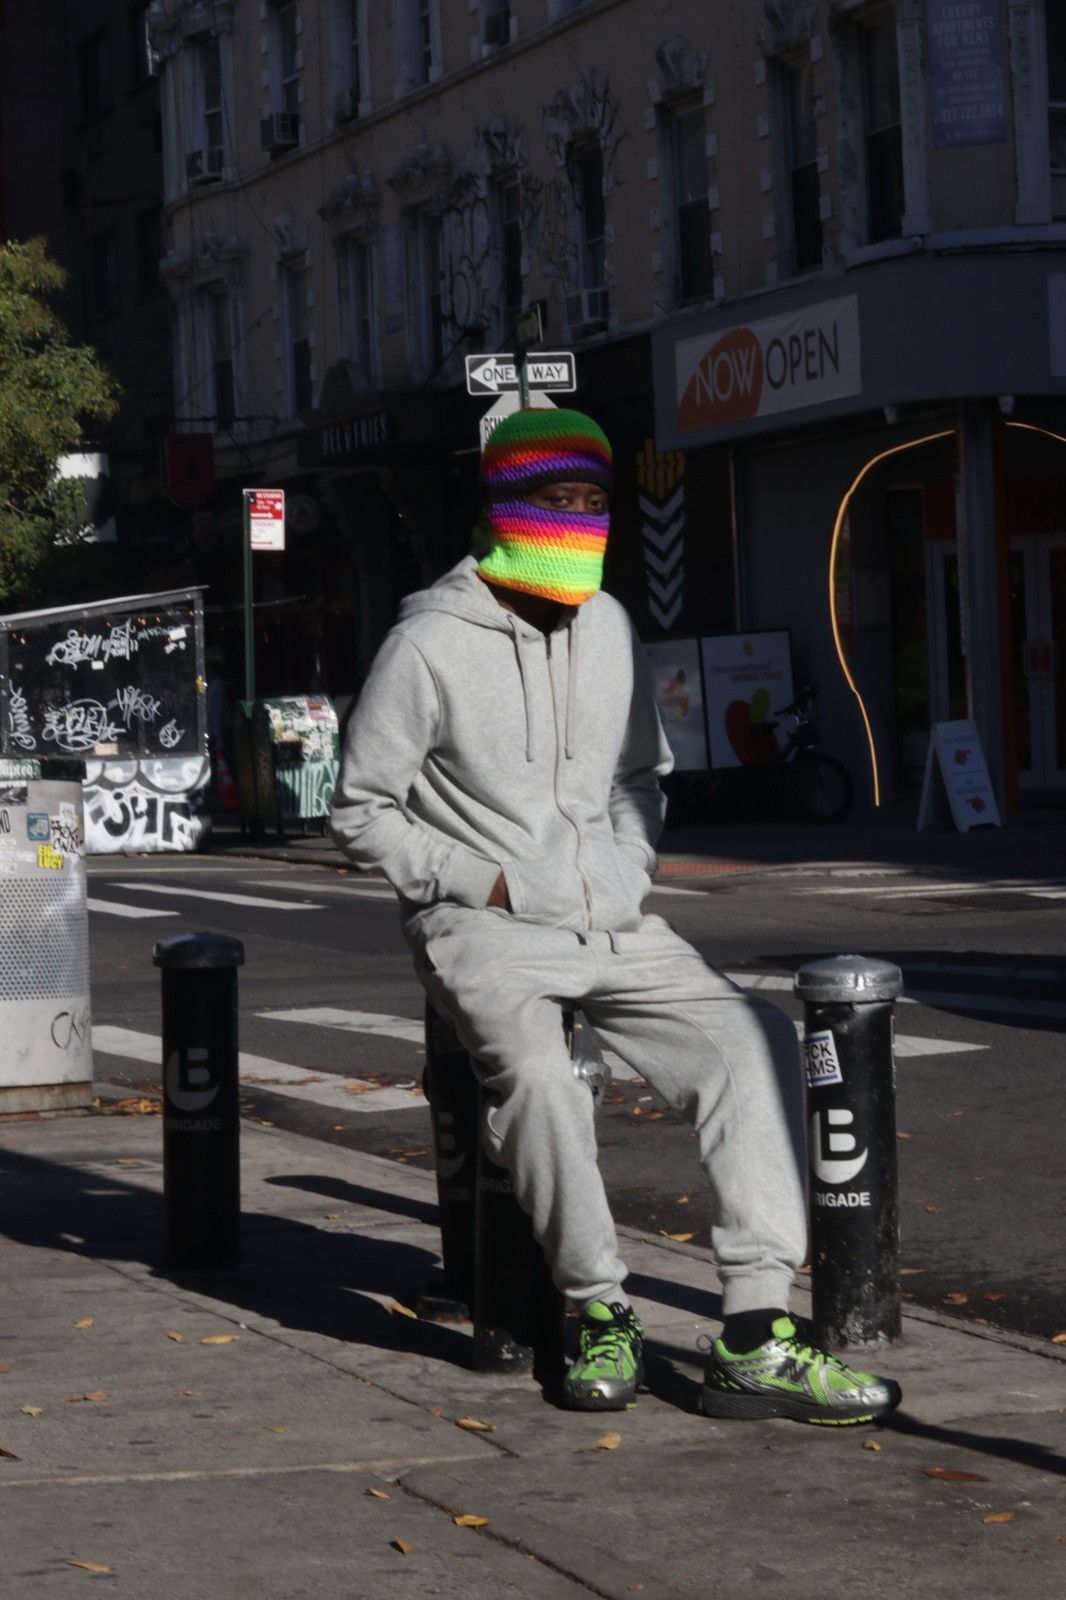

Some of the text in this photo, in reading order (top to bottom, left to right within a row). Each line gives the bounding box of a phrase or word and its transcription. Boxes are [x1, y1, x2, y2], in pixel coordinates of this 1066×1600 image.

[482, 364, 563, 382] ONE WAY
[693, 321, 839, 407] NOW OPEN
[814, 1191, 872, 1208] RIGADE
